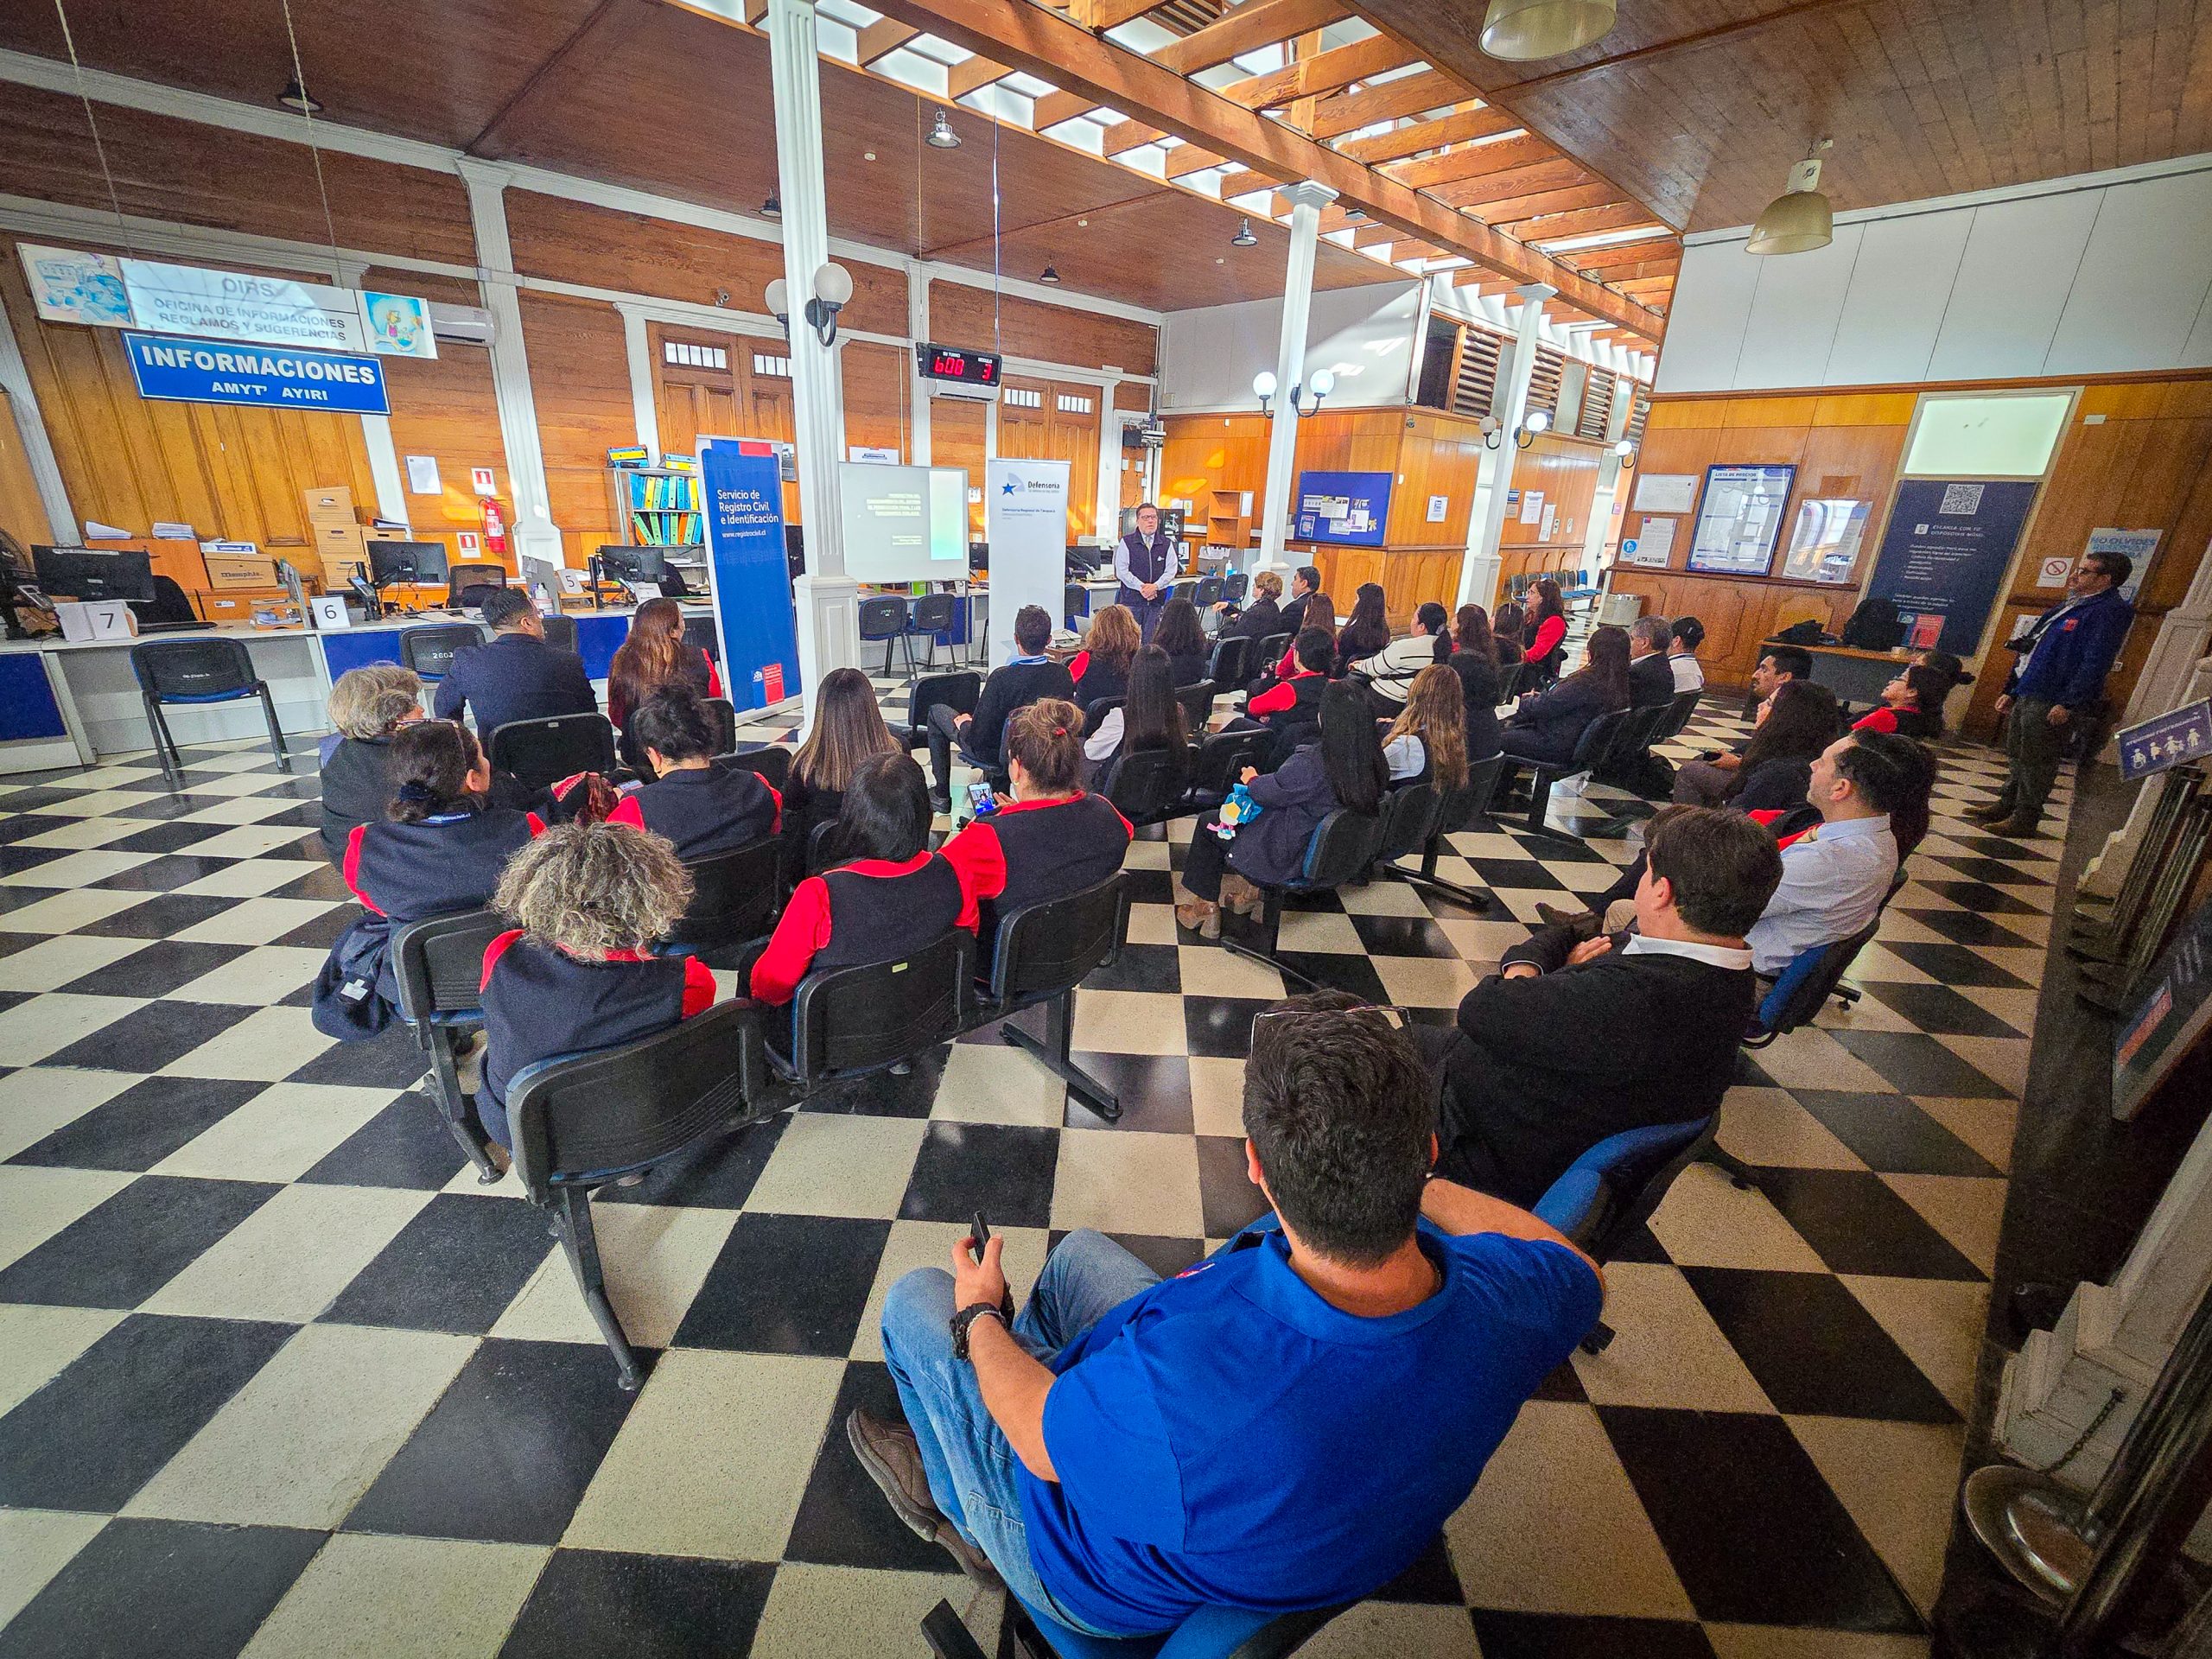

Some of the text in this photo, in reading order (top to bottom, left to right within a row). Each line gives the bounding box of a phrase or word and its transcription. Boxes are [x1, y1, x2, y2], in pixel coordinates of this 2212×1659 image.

[221, 276, 276, 297] OIRS
[154, 297, 346, 329] OFICINA DE INFORMACIONES
[159, 312, 346, 341] RECLAMOS Y SUGERENCIAS
[141, 345, 377, 385] INFORMACIONES
[934, 356, 993, 380] 600 3
[281, 386, 328, 401] AYIRI
[717, 489, 760, 500] Servicio de
[718, 501, 770, 514] Registro Civil
[720, 512, 779, 525] e Identificación
[565, 575, 575, 588] 5
[323, 604, 337, 620] 6
[99, 613, 114, 629] 7
